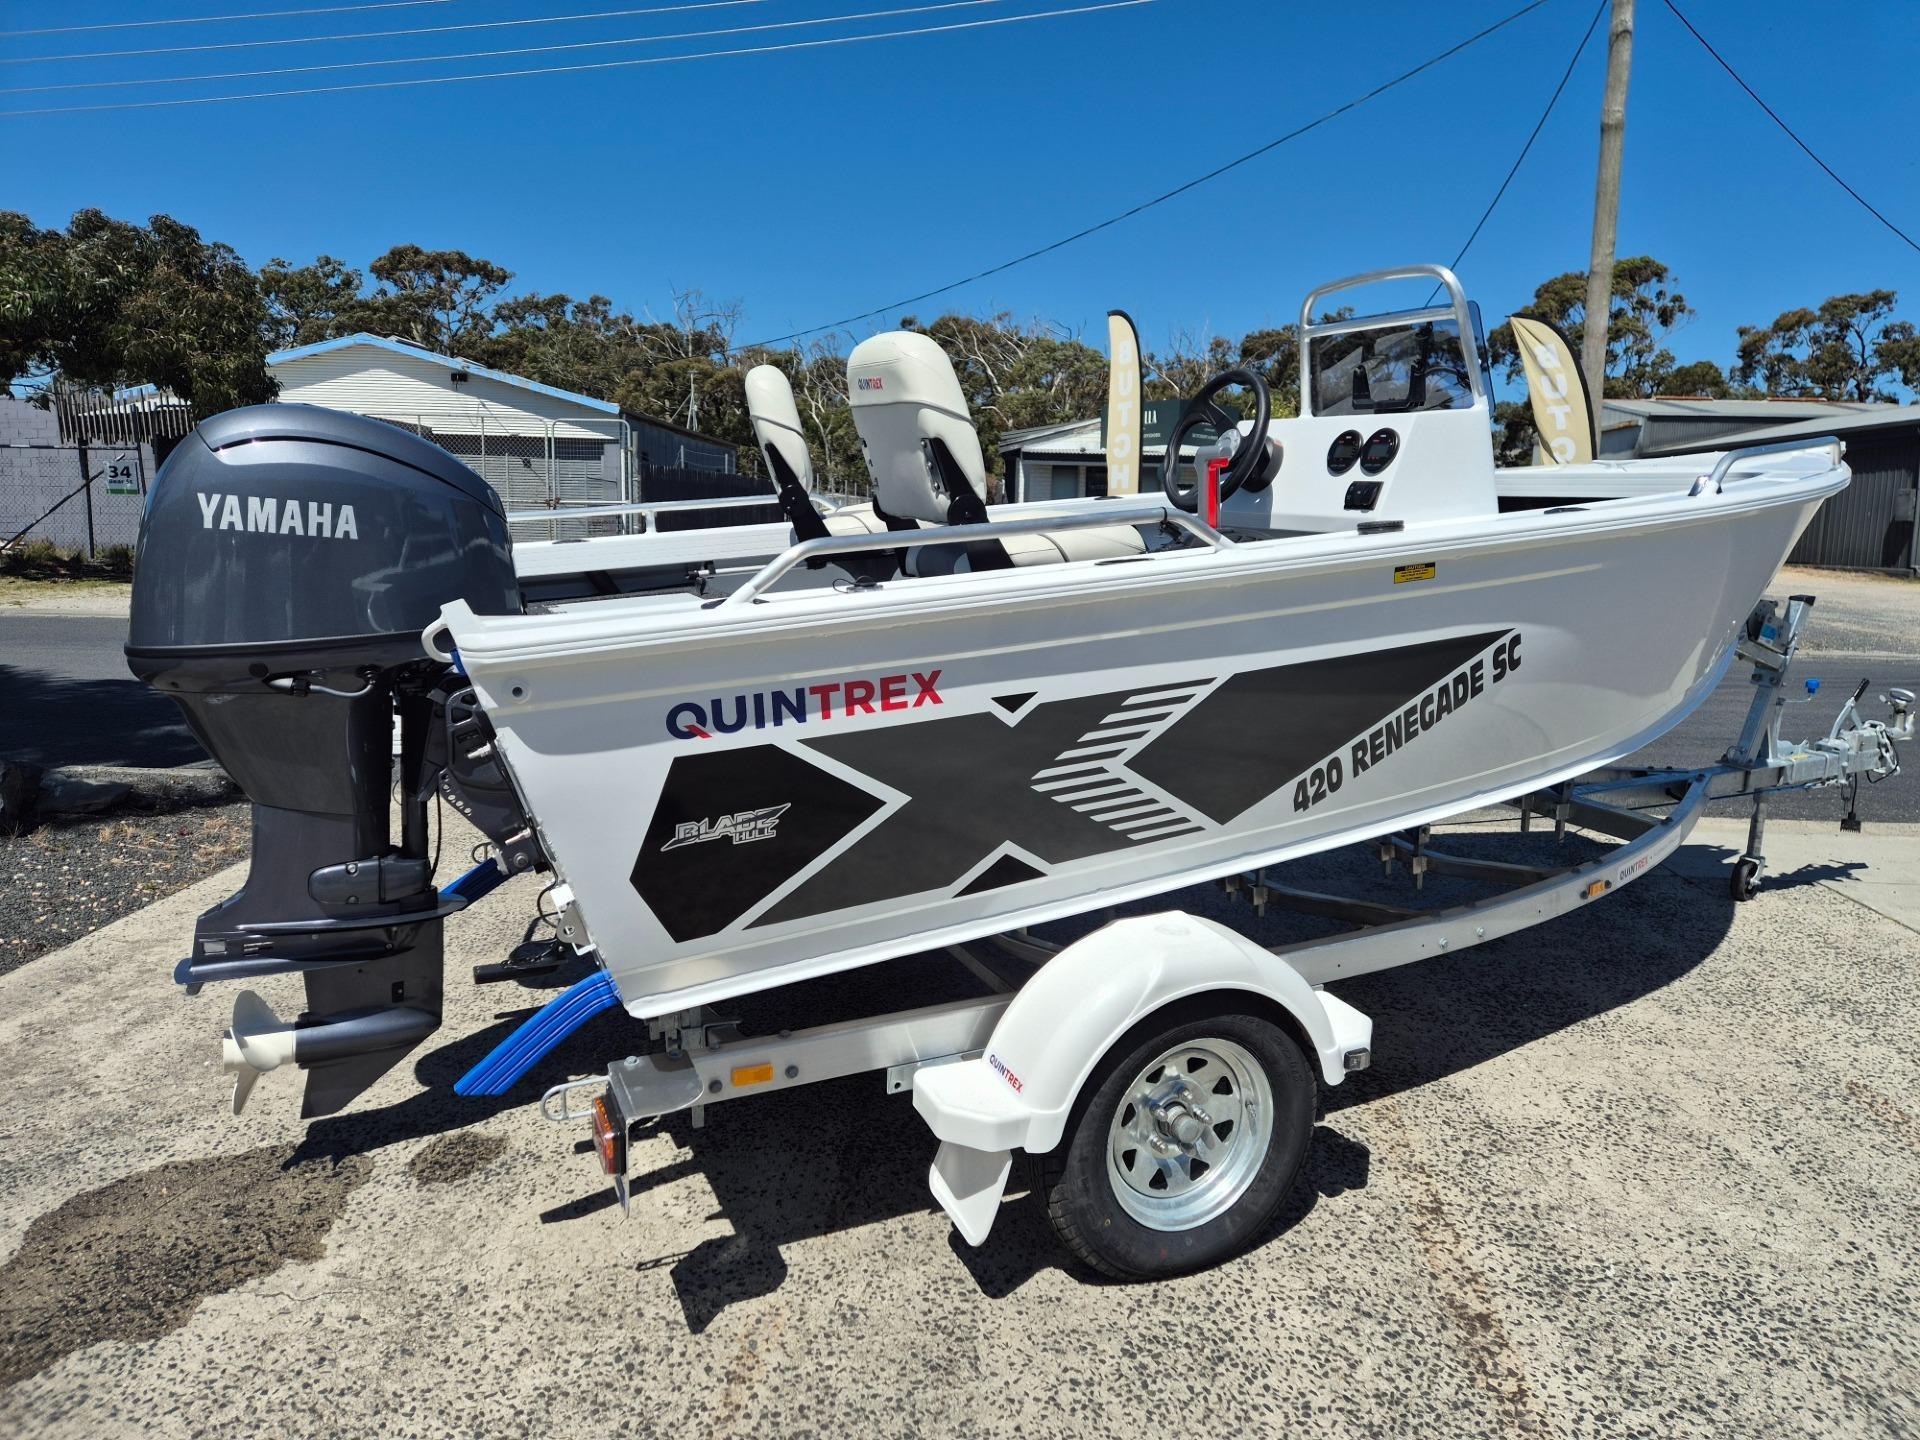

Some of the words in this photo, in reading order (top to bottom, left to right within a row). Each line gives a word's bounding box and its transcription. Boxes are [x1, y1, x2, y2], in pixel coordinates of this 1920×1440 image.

[108, 465, 131, 478] 34
[197, 492, 358, 540] YAMAHA
[665, 670, 943, 740] QUINTREX
[1293, 756, 1343, 813] 420
[1351, 658, 1484, 779] RENEGADE
[1492, 633, 1522, 684] SC
[672, 803, 791, 843] BLADE
[734, 826, 772, 842] HULL
[990, 1054, 1023, 1093] QUINTREX
